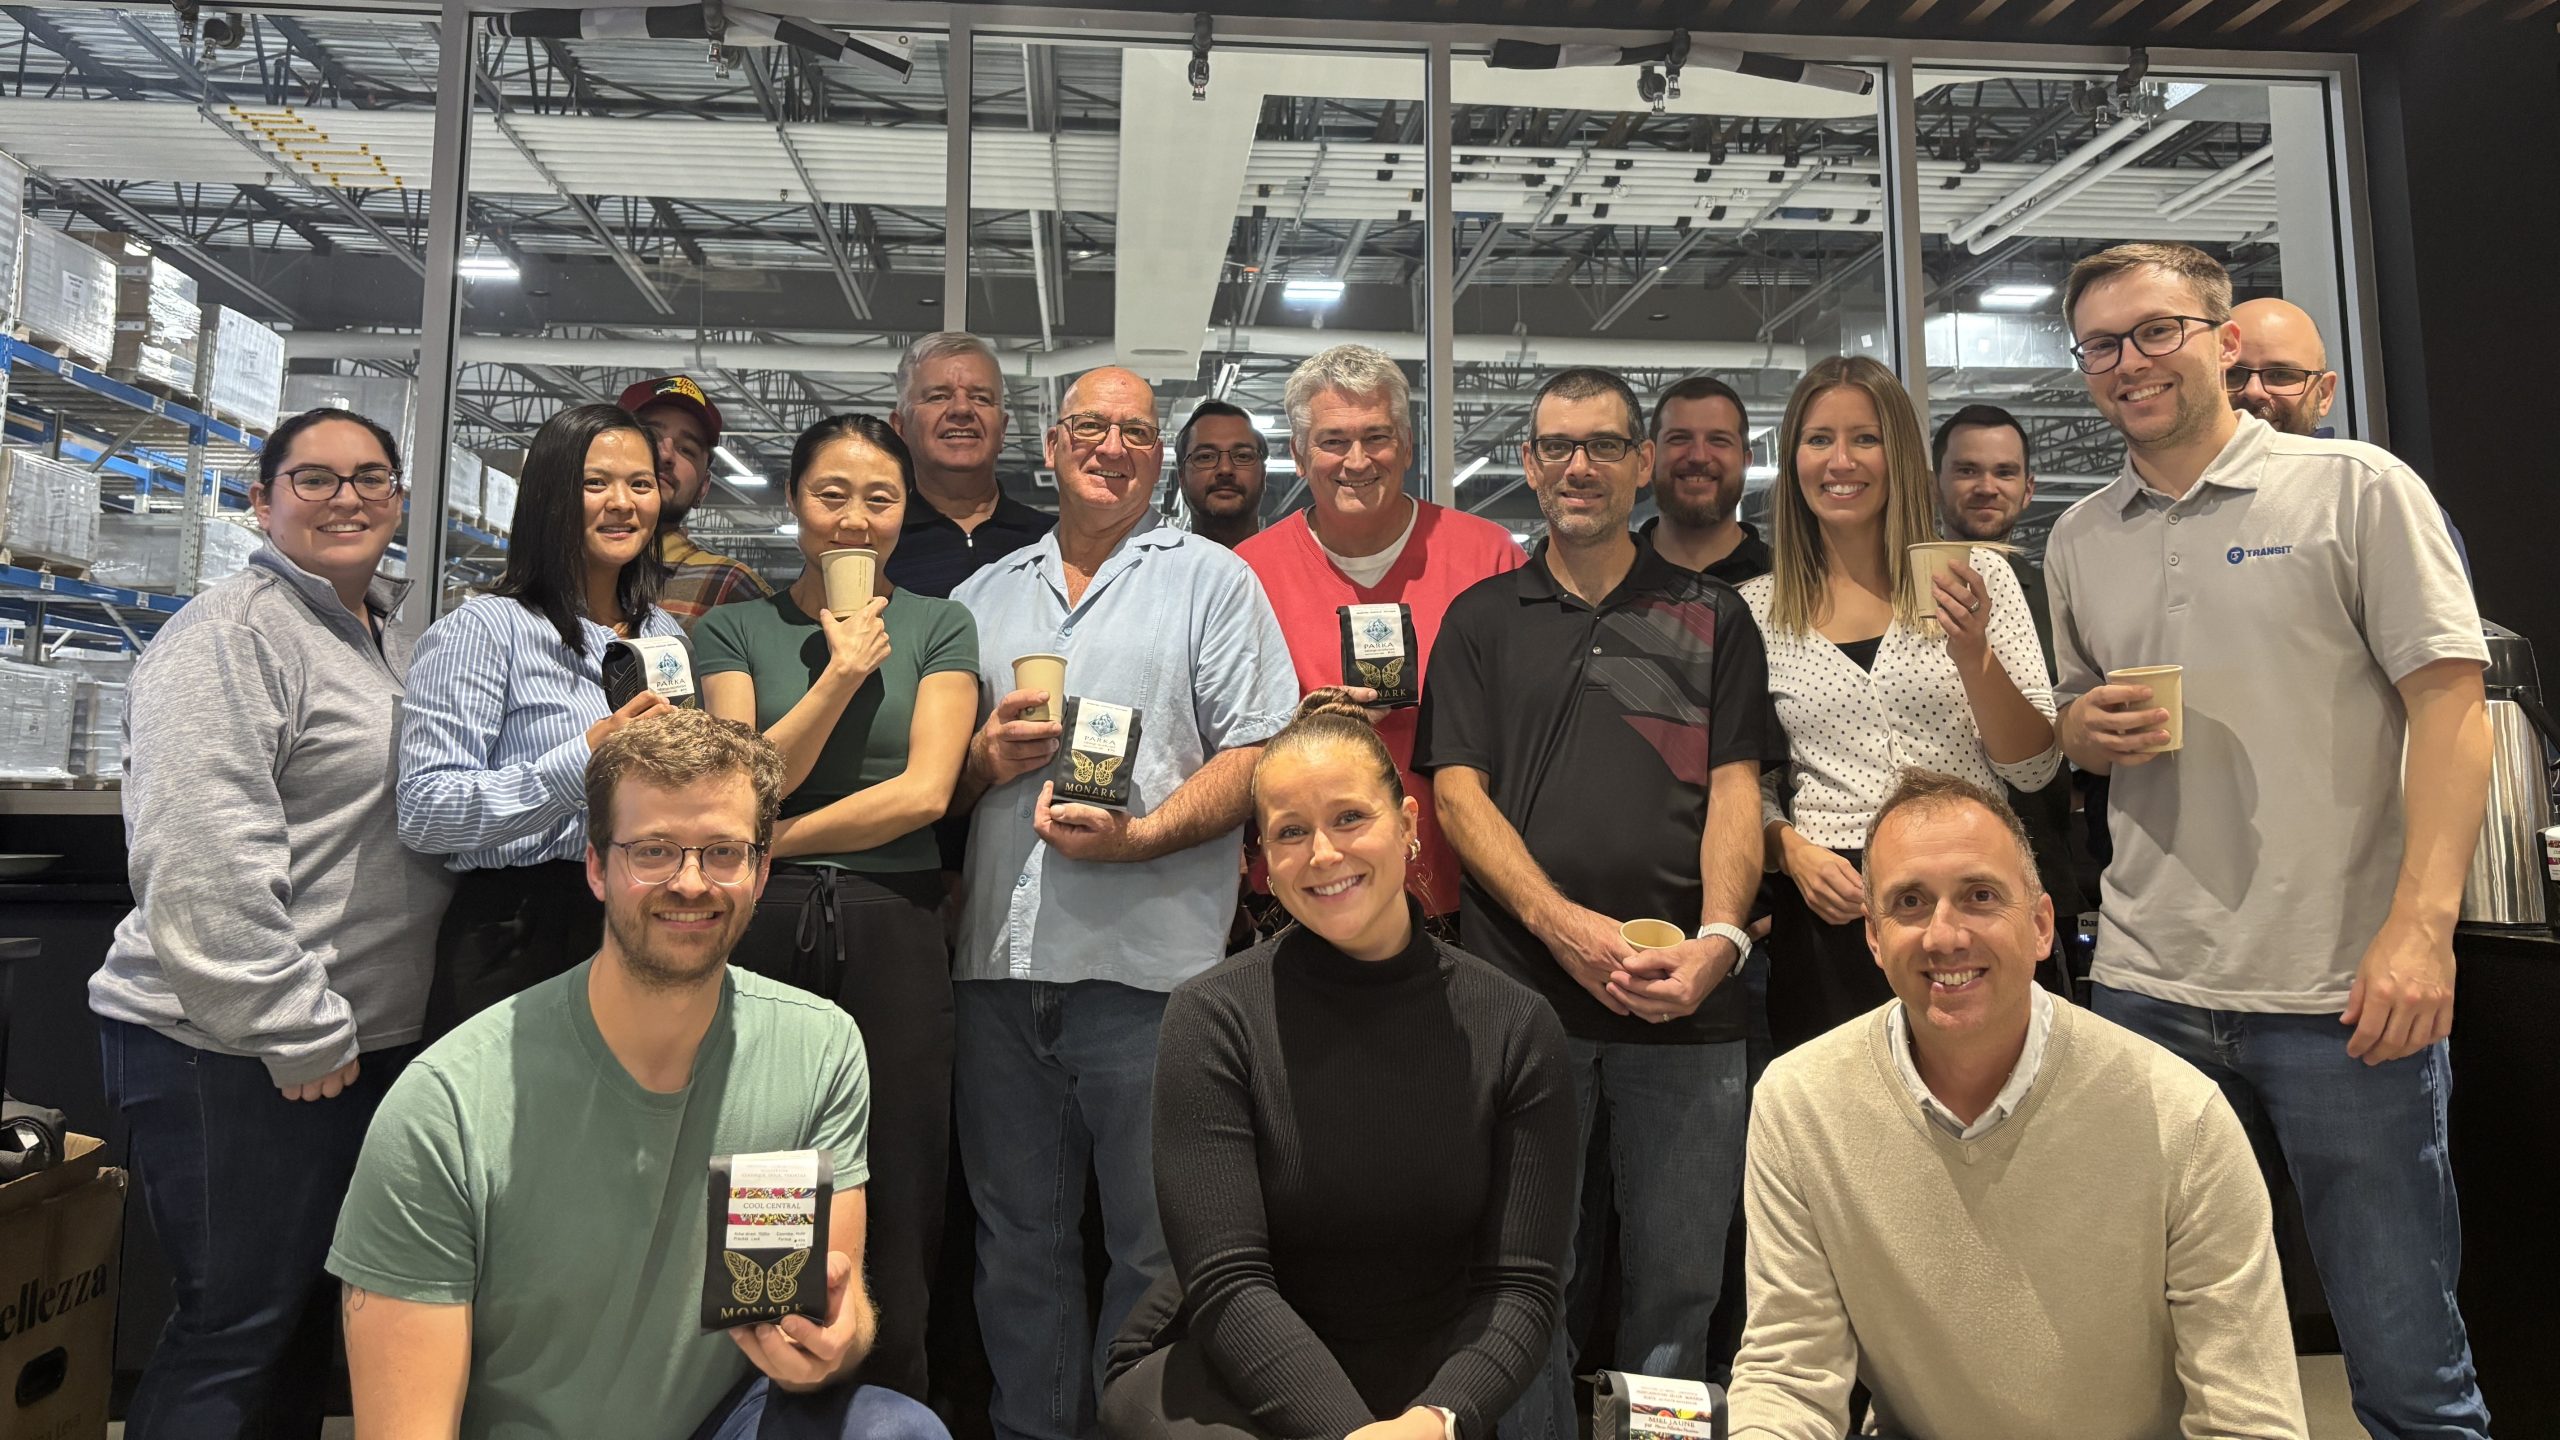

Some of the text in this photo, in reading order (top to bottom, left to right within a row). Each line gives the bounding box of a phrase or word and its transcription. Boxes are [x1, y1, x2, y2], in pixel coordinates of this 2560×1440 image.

[2246, 545, 2293, 558] TRANSIT
[656, 678, 686, 688] PARKA
[1084, 735, 1116, 746] PARKA
[1065, 782, 1116, 798] MONARK
[743, 1202, 801, 1210] COOL CENTRAL
[1648, 1416, 1695, 1428] MIEL JAUNE
